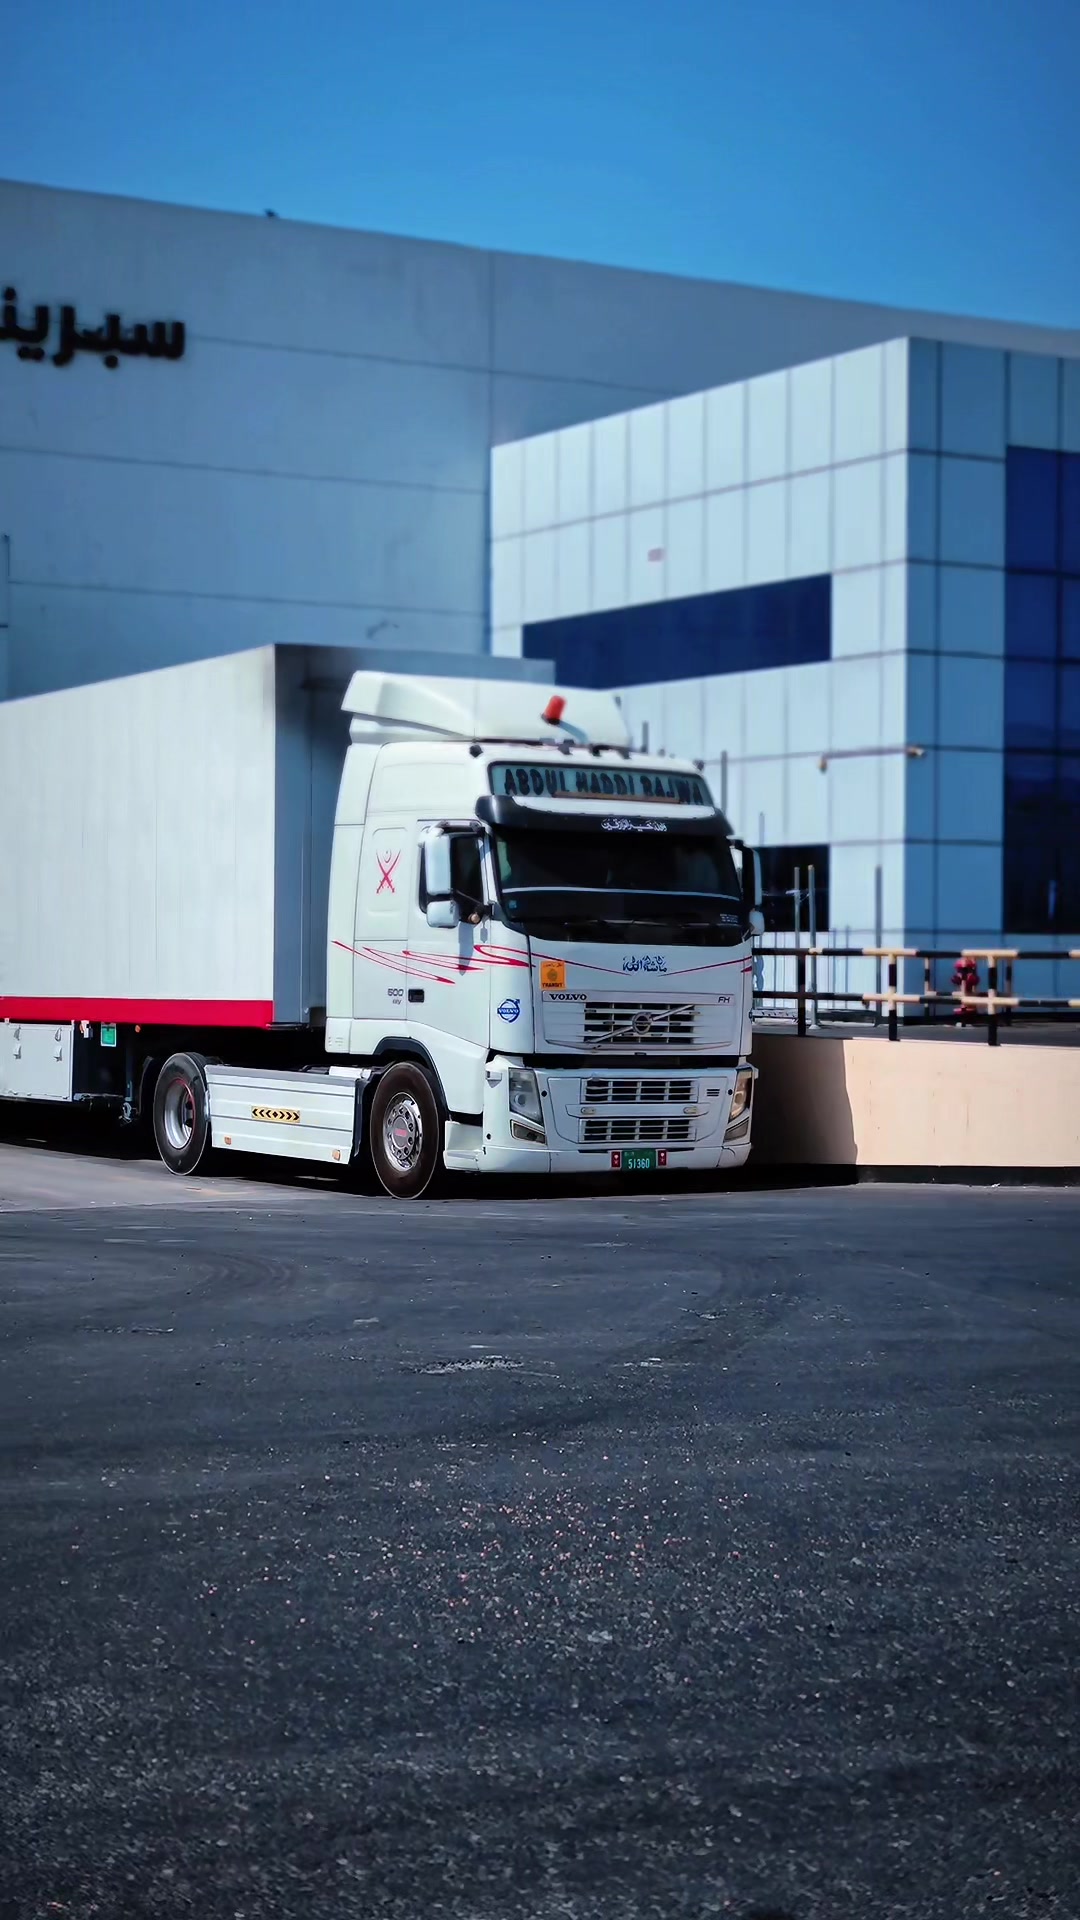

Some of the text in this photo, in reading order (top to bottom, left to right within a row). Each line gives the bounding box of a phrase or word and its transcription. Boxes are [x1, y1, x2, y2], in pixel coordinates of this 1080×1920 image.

[504, 768, 570, 796] ABDUL
[549, 993, 587, 1001] VOLVO
[628, 1158, 650, 1169] 51360
